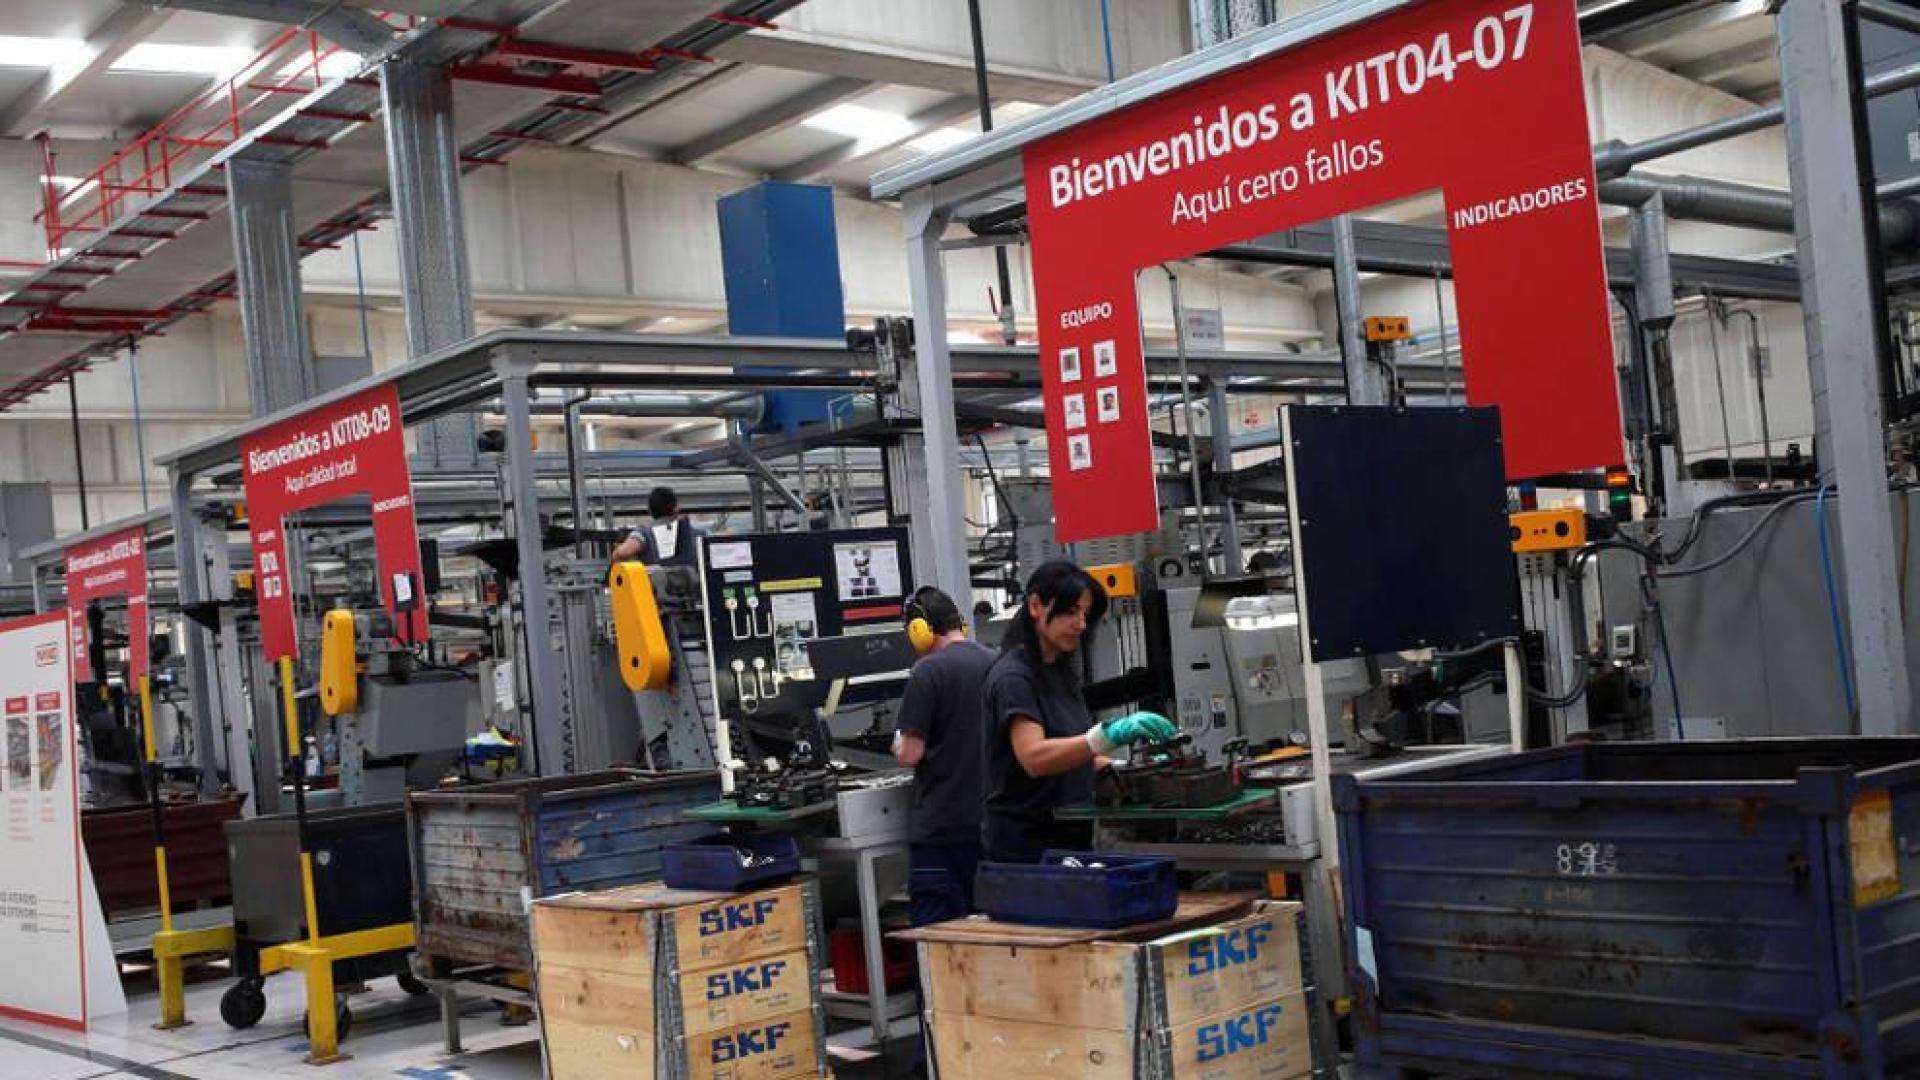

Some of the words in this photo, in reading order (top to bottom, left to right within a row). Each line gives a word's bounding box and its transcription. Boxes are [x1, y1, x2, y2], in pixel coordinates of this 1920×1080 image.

[1049, 102, 1279, 207] Bienvenidos
[1290, 91, 1315, 130] a
[1325, 4, 1535, 119] KIT04-07
[1171, 175, 1232, 226] Aquí
[1238, 166, 1299, 204] cero
[1305, 137, 1385, 185] fallos
[1454, 178, 1587, 230] INDICADORES
[1060, 302, 1112, 329] EQUIPO
[249, 431, 321, 475] Bienvenidos
[322, 431, 331, 451] a
[331, 404, 391, 447] KIT08-09
[336, 455, 357, 479] total
[698, 898, 779, 937] SKF
[1188, 921, 1273, 977] SKF
[706, 961, 786, 1000] SKF
[711, 1022, 791, 1063] SKF
[1197, 1005, 1283, 1062] SKF
